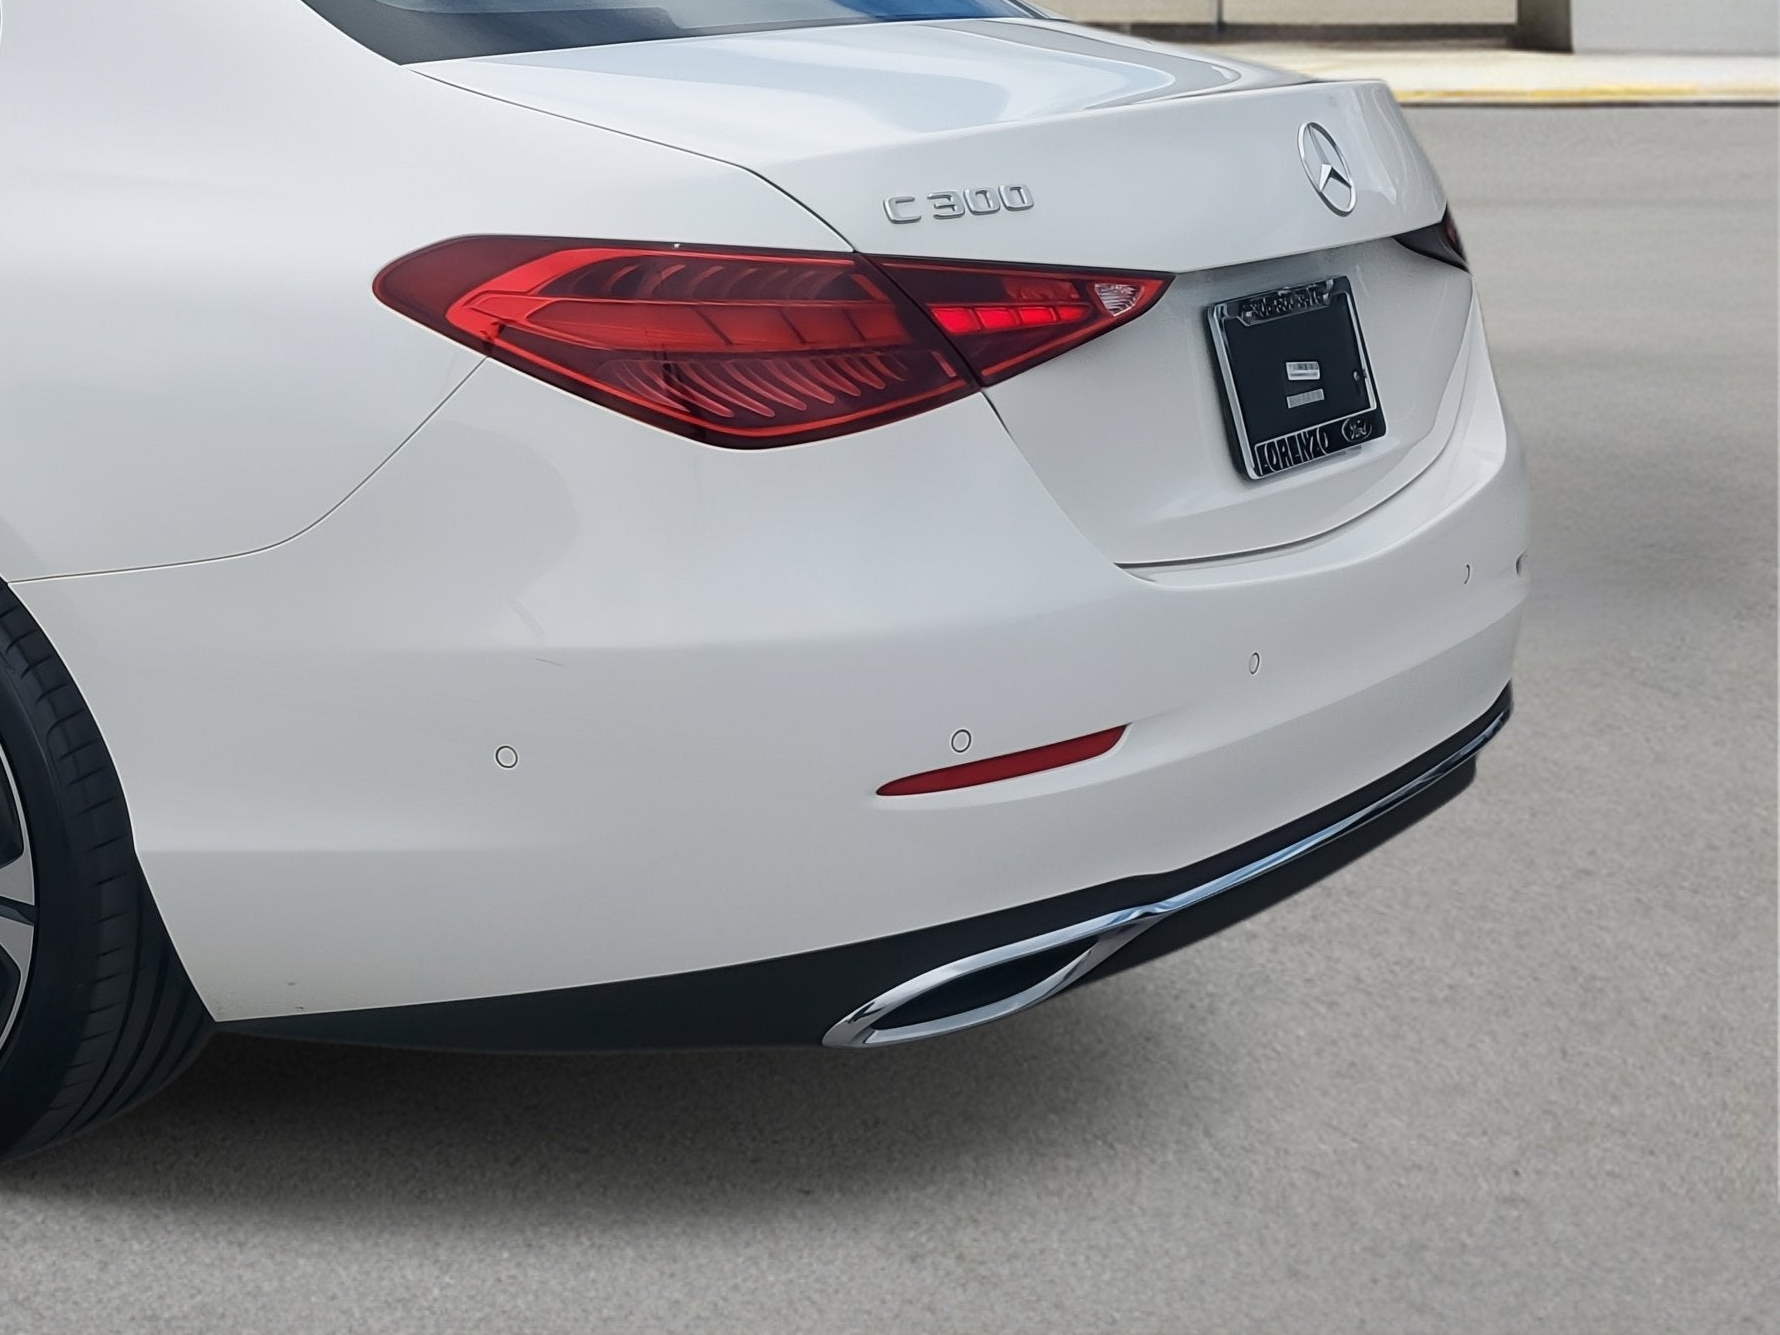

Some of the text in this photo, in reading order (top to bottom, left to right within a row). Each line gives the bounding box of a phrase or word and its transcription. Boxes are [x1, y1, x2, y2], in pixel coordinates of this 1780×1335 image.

[883, 183, 1035, 225] C 300
[1254, 426, 1330, 476] LORENZO
